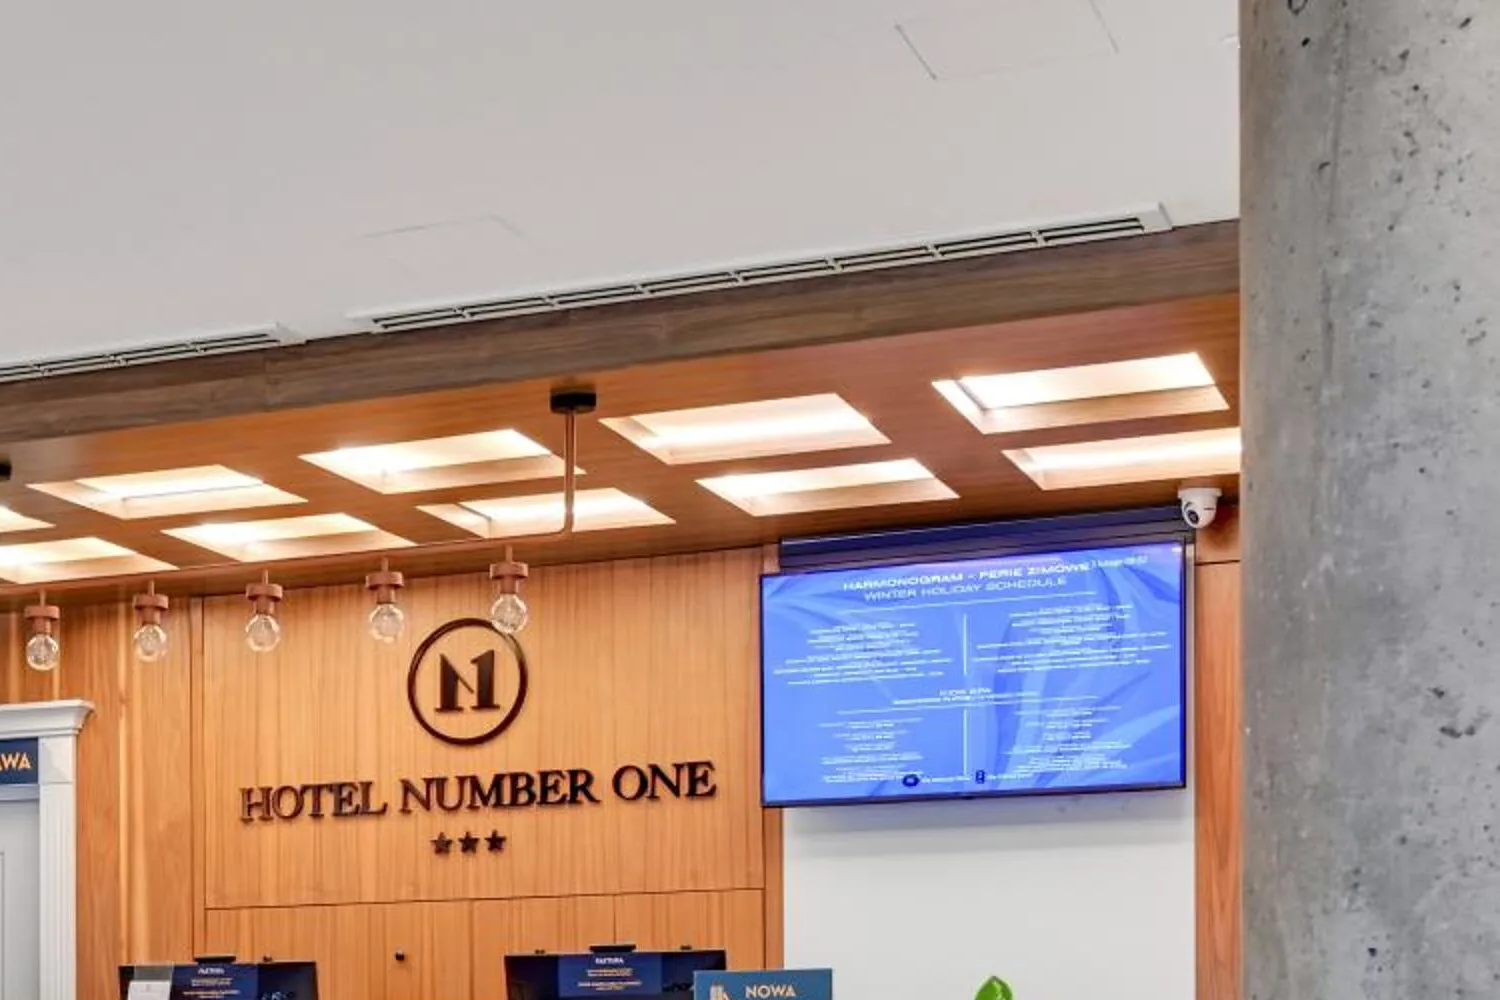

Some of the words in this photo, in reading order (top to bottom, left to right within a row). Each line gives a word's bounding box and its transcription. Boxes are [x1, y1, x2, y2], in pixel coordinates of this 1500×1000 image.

[864, 587, 917, 602] WINTER
[921, 583, 981, 598] HOLIDAY
[985, 576, 1067, 592] SCHEDULE
[240, 781, 388, 824] HOTEL
[399, 768, 601, 814] NUMBER
[612, 760, 717, 801] ONE
[745, 984, 797, 999] NOWA
